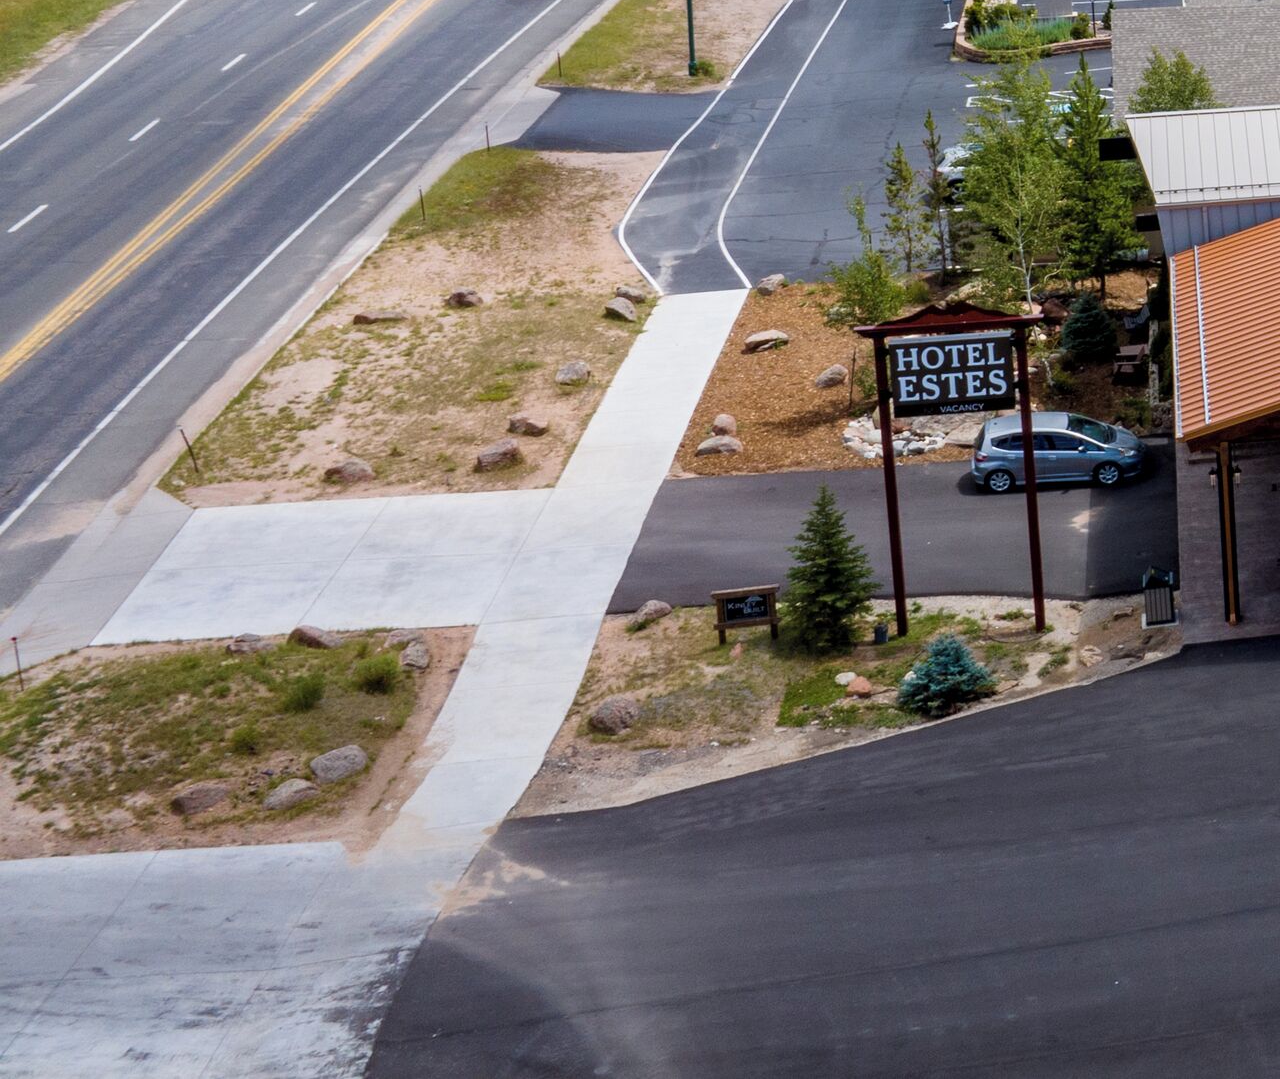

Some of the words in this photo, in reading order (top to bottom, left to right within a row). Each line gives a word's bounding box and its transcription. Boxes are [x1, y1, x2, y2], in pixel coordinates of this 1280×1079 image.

[895, 342, 1006, 371] HOTEL
[897, 369, 1007, 402] ESTES
[940, 402, 985, 414] VACANCY
